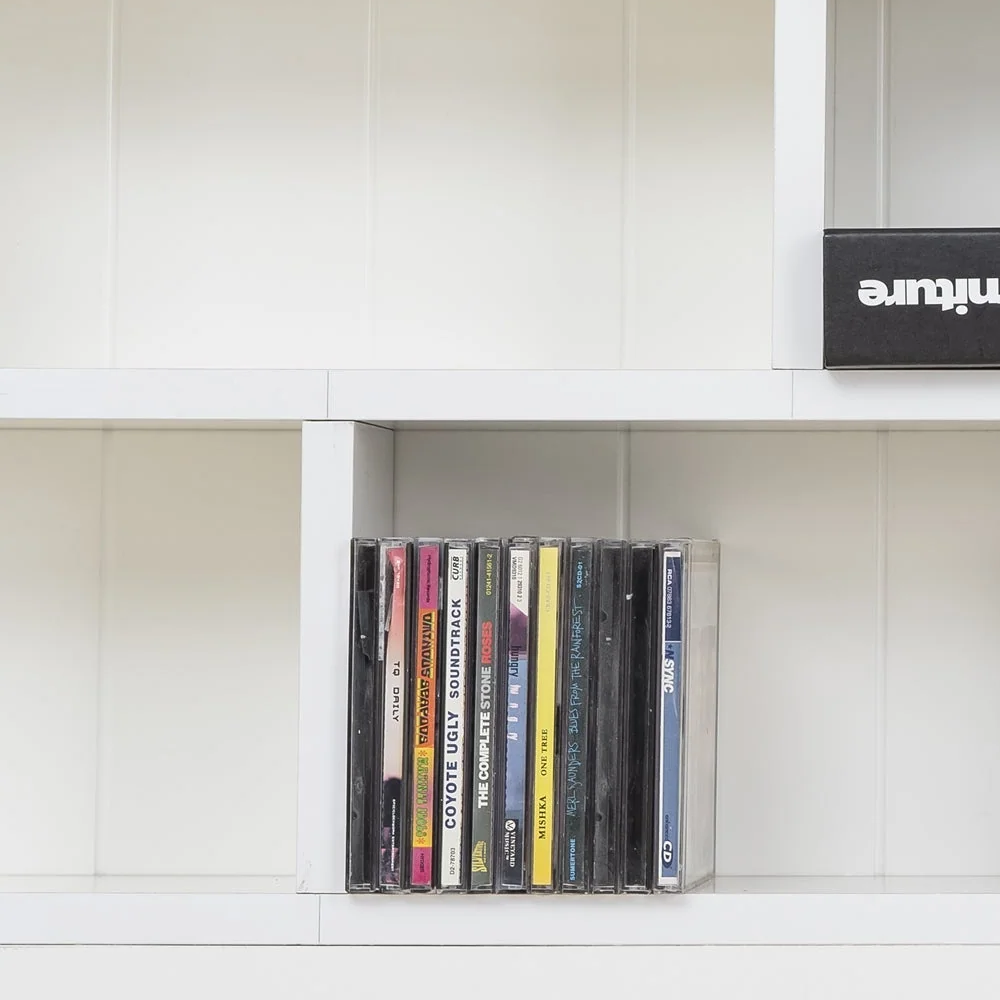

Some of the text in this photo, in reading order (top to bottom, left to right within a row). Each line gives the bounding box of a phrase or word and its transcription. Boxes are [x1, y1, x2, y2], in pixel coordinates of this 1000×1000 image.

[452, 556, 461, 581] CURB
[509, 646, 521, 677] hungry
[391, 660, 401, 722] TQ DAILY
[444, 598, 462, 829] COYOTE UGLY SOUNDTRACK
[477, 621, 493, 809] THE COMPLETE STONE ROSES
[566, 597, 584, 817] MERL SAUNDERS BLUES FROM THE RAINFOREST
[538, 795, 547, 840] MISHKA
[663, 840, 673, 863] CD
